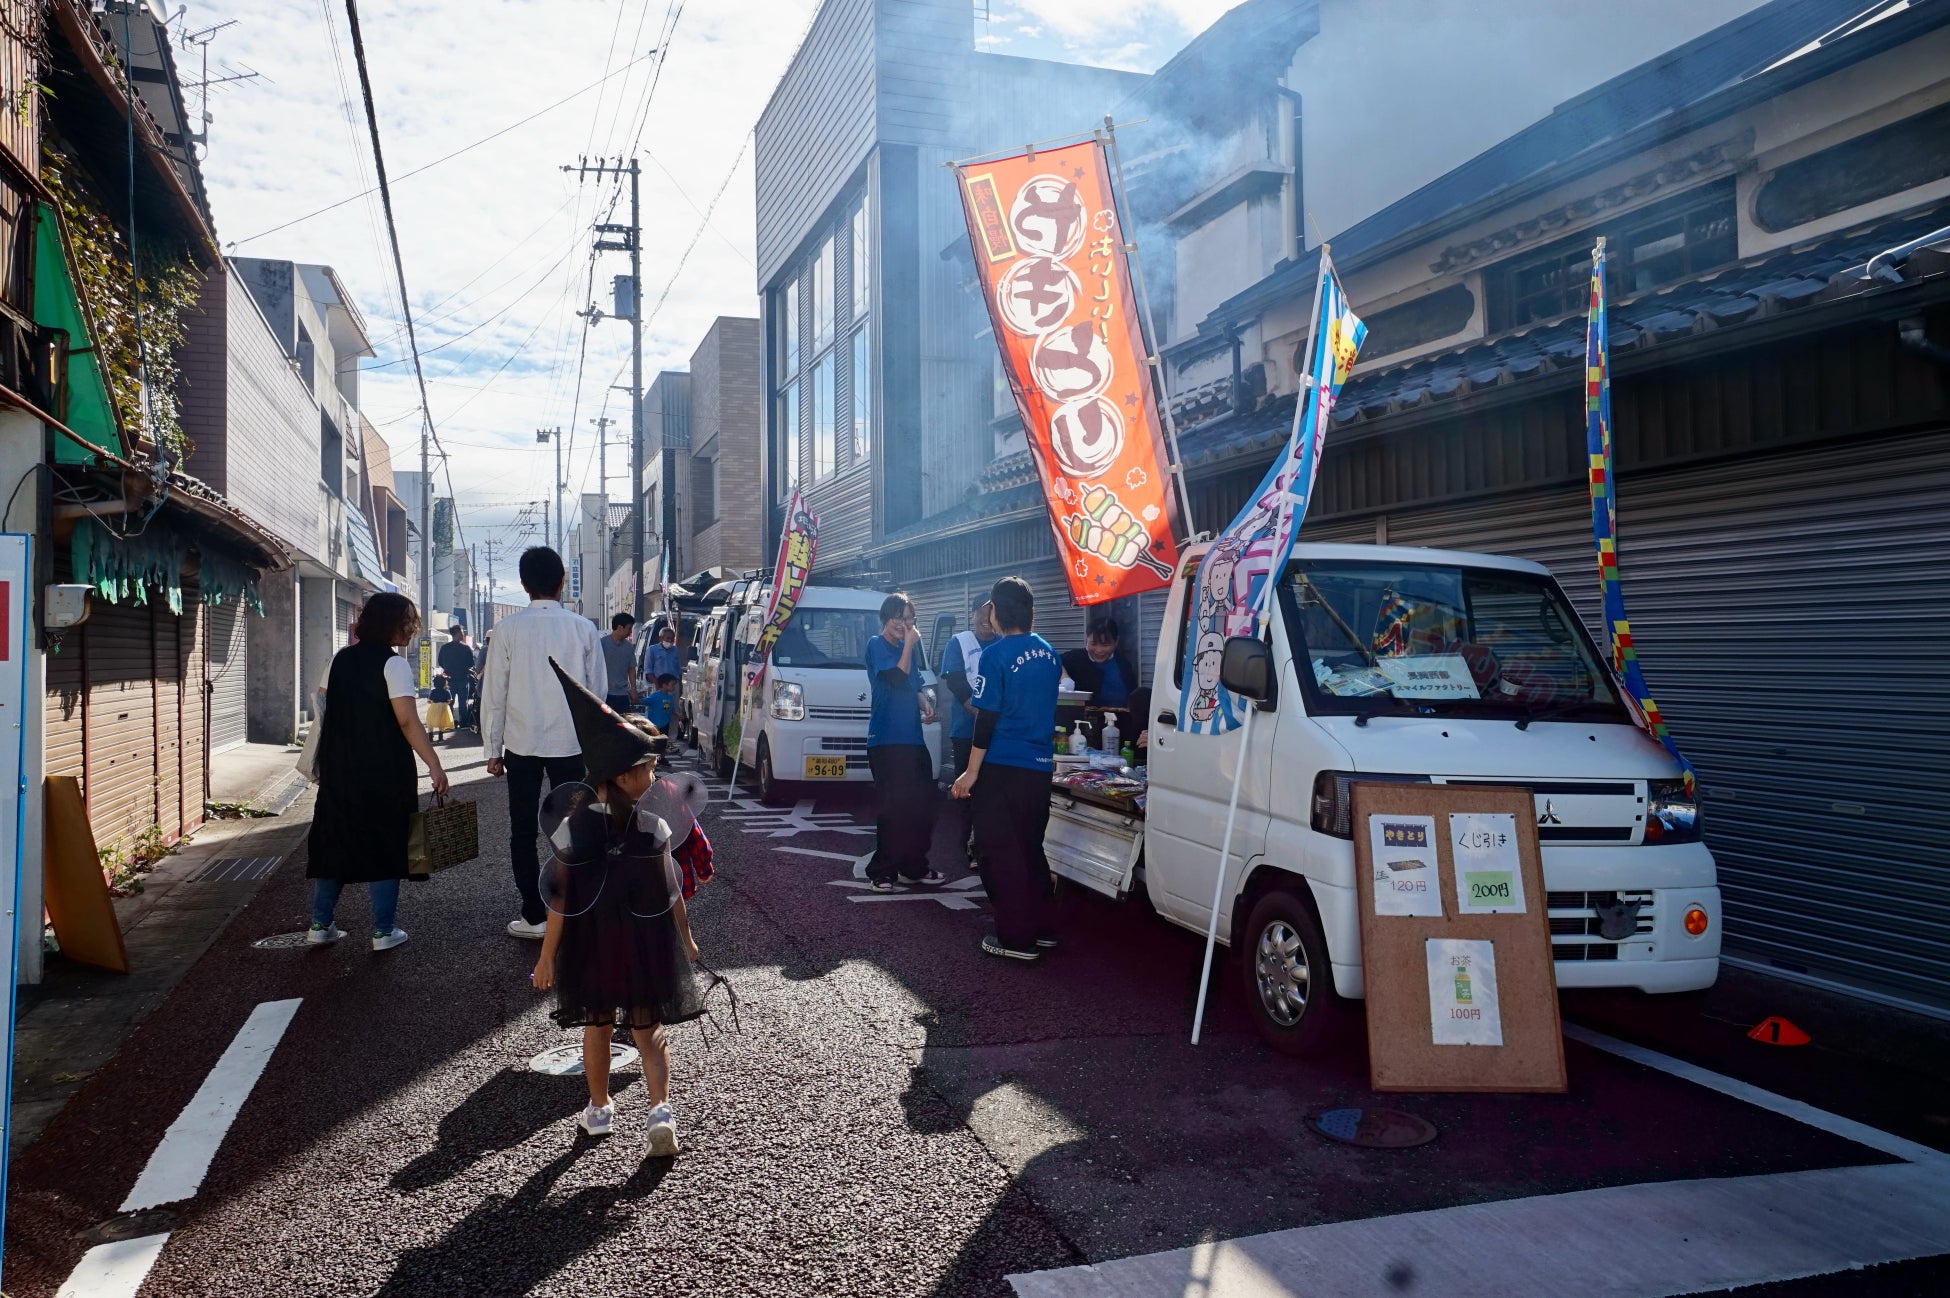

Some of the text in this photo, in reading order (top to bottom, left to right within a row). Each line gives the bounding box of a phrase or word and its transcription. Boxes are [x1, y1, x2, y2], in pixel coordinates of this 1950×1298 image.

[1395, 683, 1472, 692] スマイルファクトリー
[814, 764, 844, 776] 96-09
[1385, 829, 1425, 842] やきとり
[1458, 832, 1508, 850] くじ引き
[1390, 880, 1427, 892] 120円
[1472, 882, 1510, 898] 200円
[1450, 955, 1472, 967] お茶
[1450, 1008, 1481, 1020] 100円
[1769, 1021, 1781, 1043] 1
